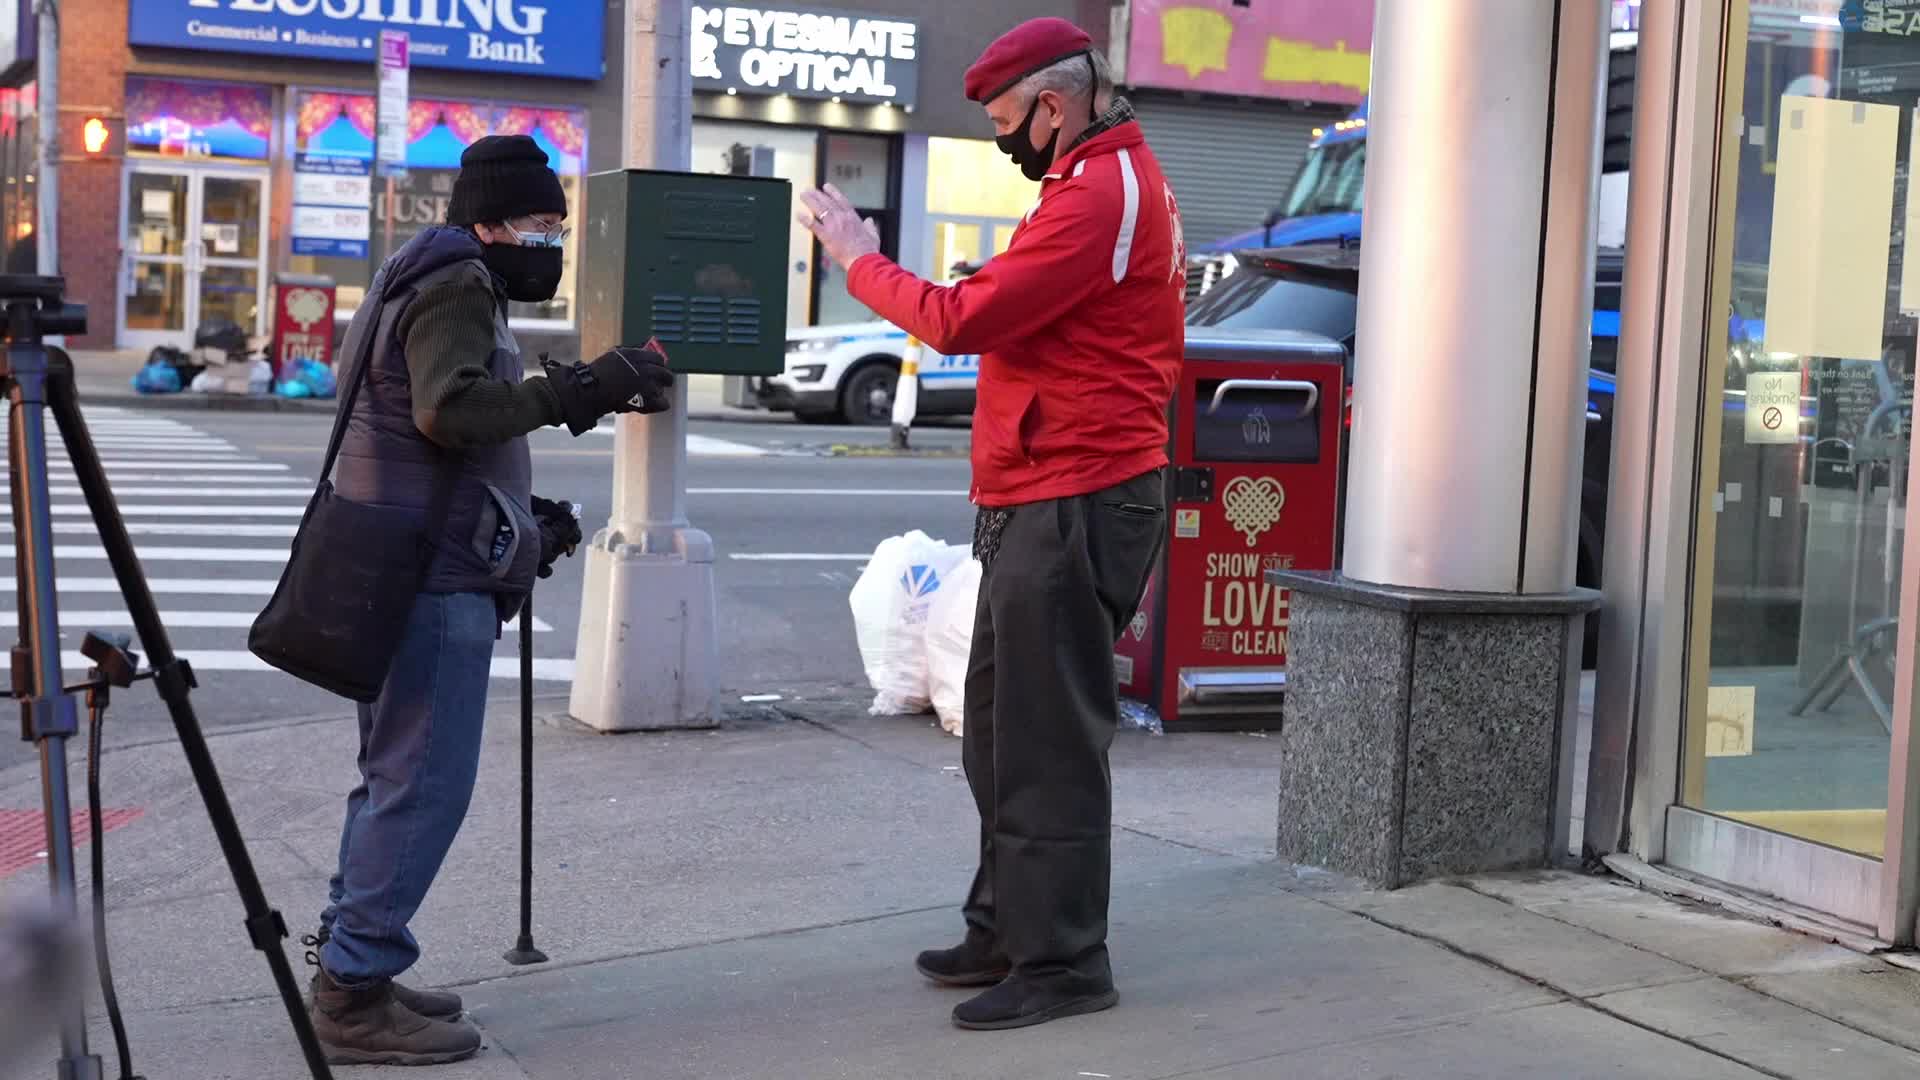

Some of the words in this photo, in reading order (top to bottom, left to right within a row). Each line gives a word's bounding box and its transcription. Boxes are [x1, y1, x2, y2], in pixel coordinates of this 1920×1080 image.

[187, 20, 278, 42] Commercial
[295, 29, 359, 48] Business
[189, 0, 548, 35] HING
[723, 7, 916, 60] EYESMATE
[467, 33, 545, 64] Bank
[740, 48, 896, 97] OPTICAL
[1206, 552, 1260, 577] SHOW
[1203, 580, 1289, 626] LOVE
[1231, 630, 1289, 655] CLEAN
